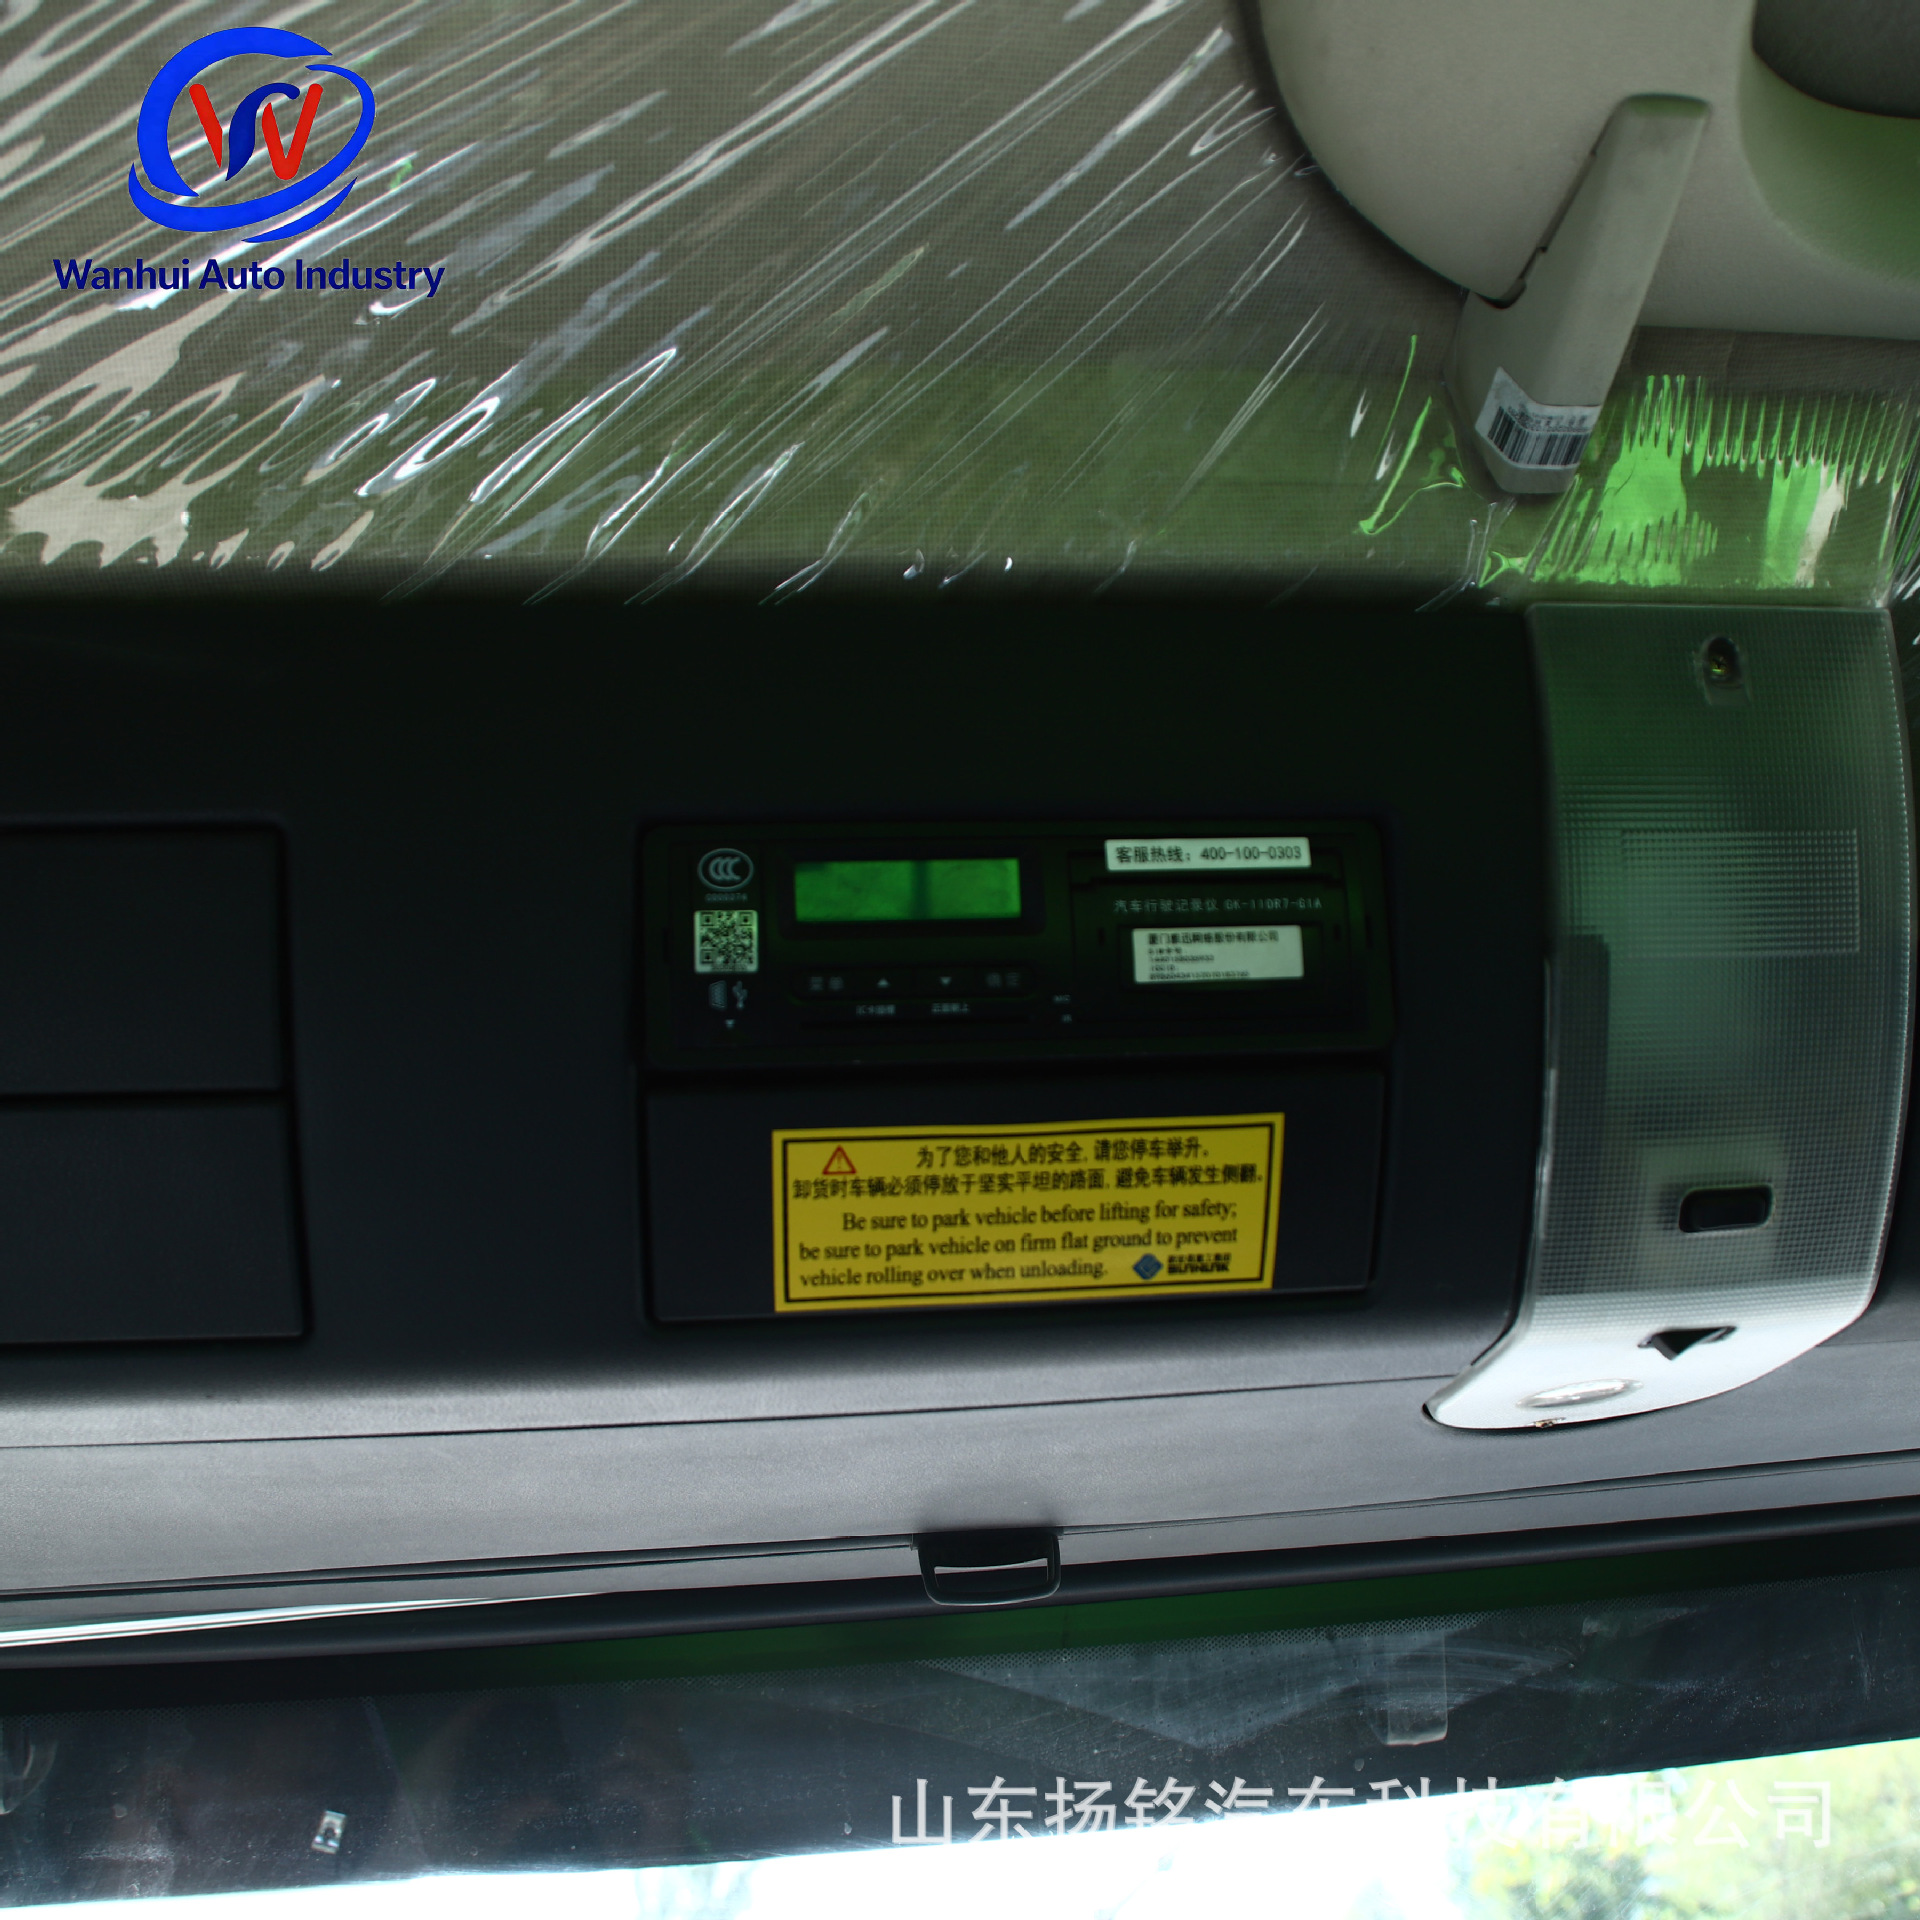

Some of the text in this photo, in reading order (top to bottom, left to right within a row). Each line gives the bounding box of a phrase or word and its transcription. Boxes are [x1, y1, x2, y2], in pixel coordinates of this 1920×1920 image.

[1200, 845, 1302, 861] 400-100-0303
[843, 1198, 1237, 1232] Be sure to park vehicle before lifting for safety;
[799, 1228, 1238, 1261] be sure to park vehicle on firm flat ground to prevent
[800, 1259, 1108, 1287] vehicle rolling over when unloading.
